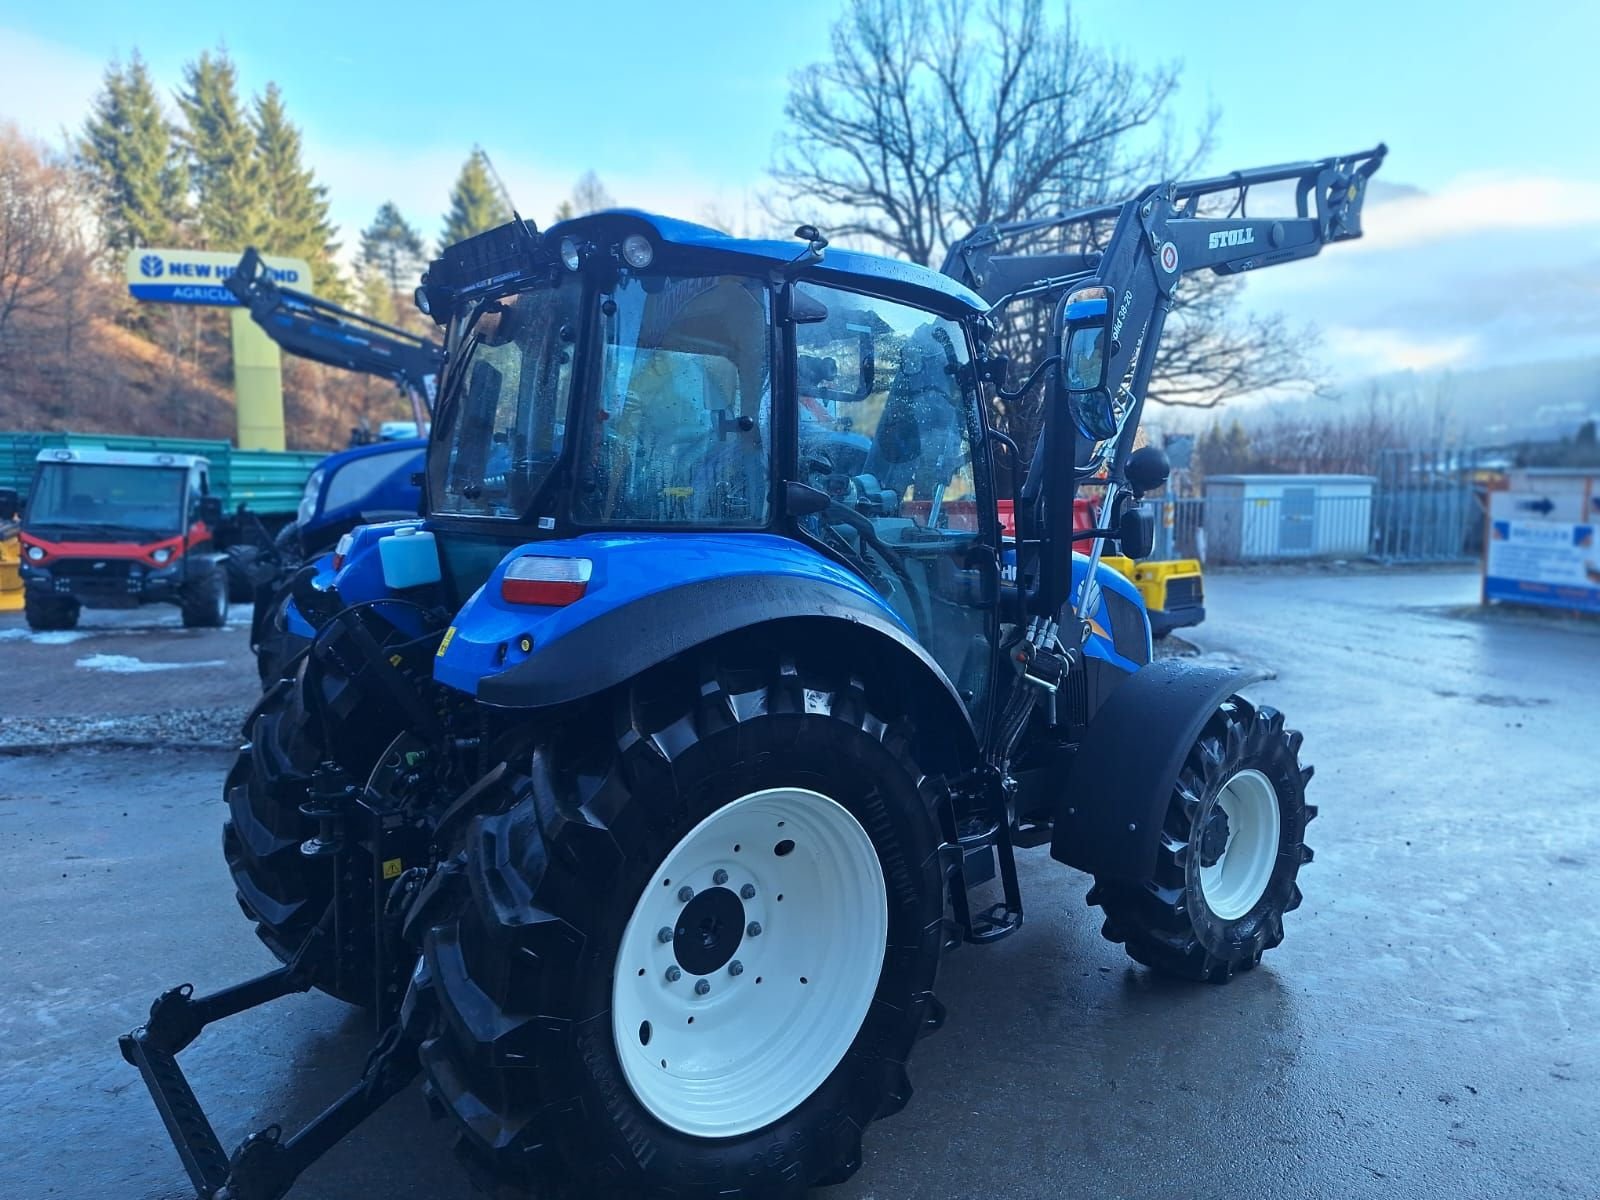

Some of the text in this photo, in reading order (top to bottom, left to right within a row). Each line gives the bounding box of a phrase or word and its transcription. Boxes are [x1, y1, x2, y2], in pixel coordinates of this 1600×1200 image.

[1208, 227, 1255, 249] STOLL
[168, 262, 211, 278] NEW
[1112, 290, 1133, 341] olid 38-20
